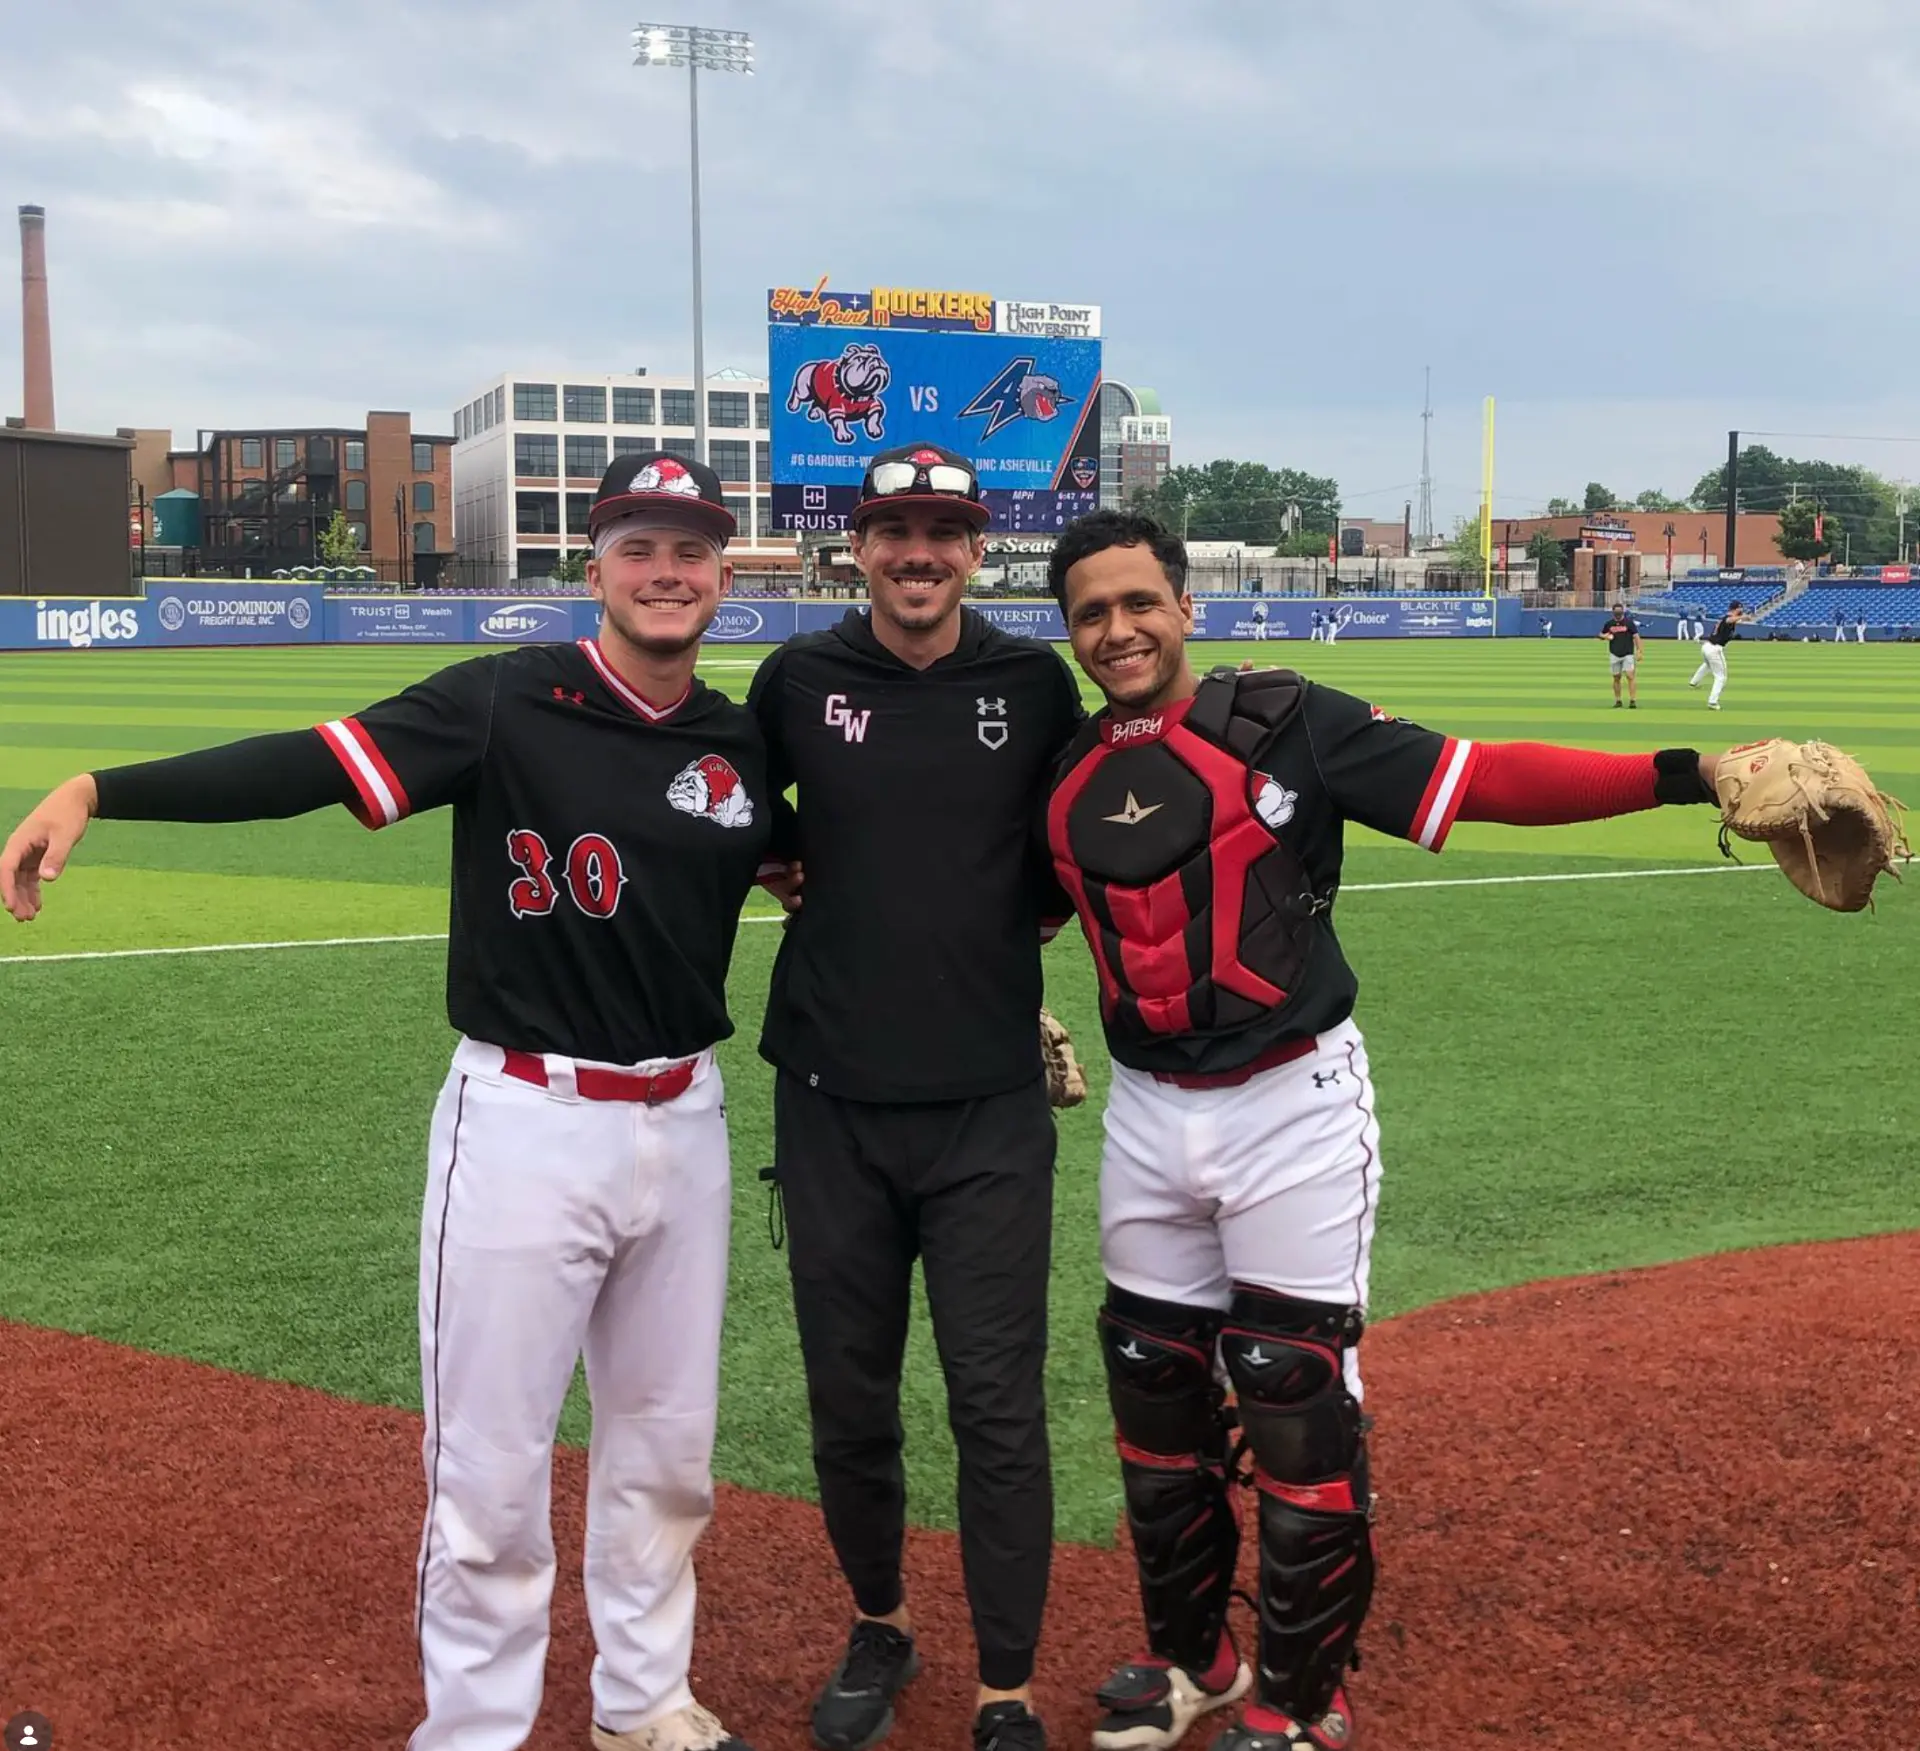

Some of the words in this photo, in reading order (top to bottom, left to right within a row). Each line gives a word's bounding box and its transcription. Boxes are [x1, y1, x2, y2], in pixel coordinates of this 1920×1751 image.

[771, 276, 828, 315] High
[818, 299, 870, 325] Point
[871, 287, 993, 331] ROCKERS
[1006, 303, 1044, 321] HIGH
[1050, 306, 1091, 322] POINT
[1006, 317, 1090, 336] UNIVERSITY
[909, 386, 938, 412] VS
[976, 459, 996, 471] UNC
[999, 460, 1052, 473] ASHEVILLE
[1012, 491, 1035, 500] MPH
[782, 514, 848, 529] TRUIST
[187, 600, 215, 615] OLD
[218, 600, 286, 615] DOMINION
[350, 606, 392, 616] TRUIST
[421, 608, 452, 616] Wealth
[1400, 602, 1439, 611] BLACK
[1443, 602, 1461, 611] TIE
[37, 600, 139, 647] ingles
[199, 615, 235, 626] FREIGHT
[259, 616, 275, 626] INC.
[488, 616, 526, 630] NFI
[1353, 611, 1386, 624] Choice
[825, 694, 871, 743] GW
[507, 828, 629, 919] 30
